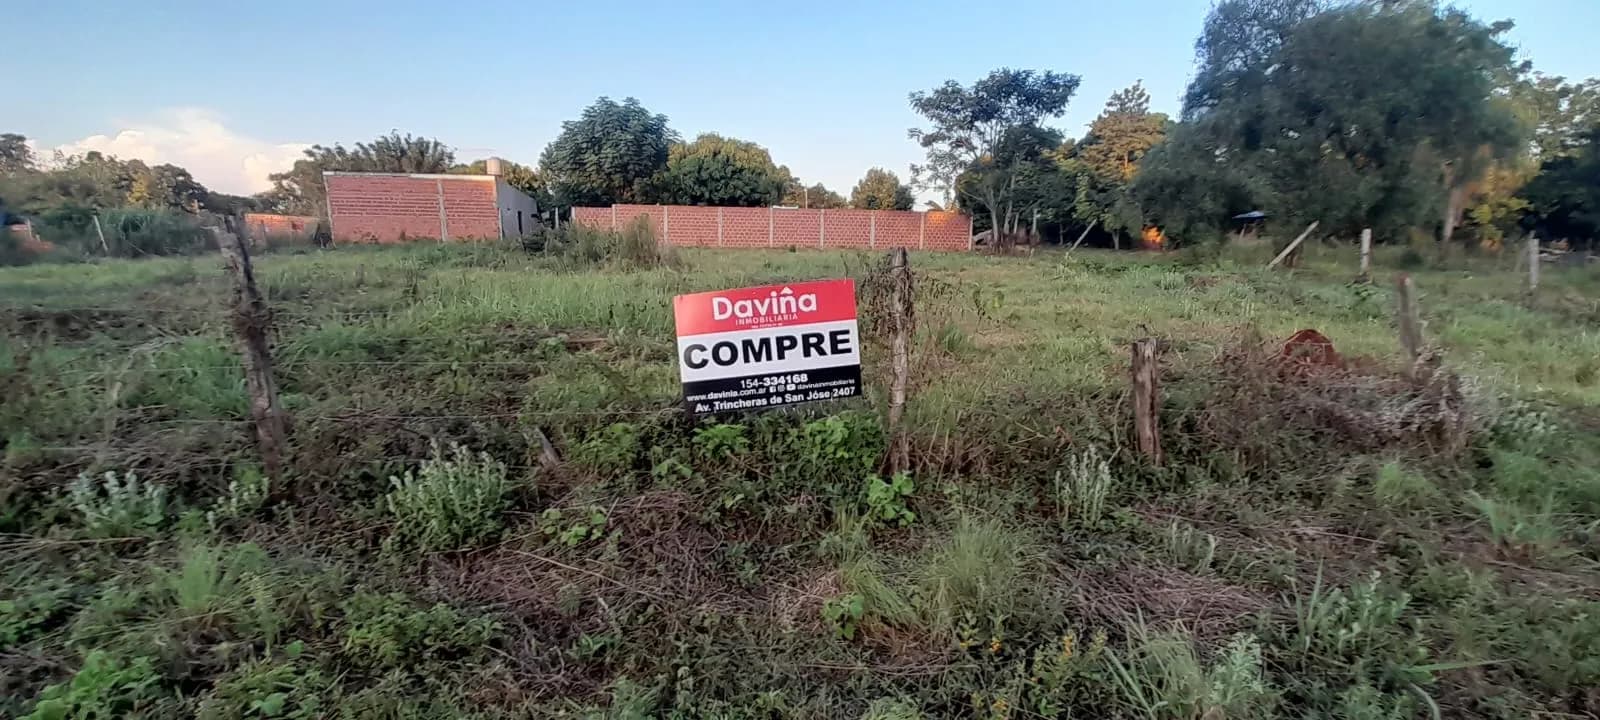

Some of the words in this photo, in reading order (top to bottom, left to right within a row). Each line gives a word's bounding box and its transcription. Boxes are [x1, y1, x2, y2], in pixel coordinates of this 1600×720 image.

[735, 313, 798, 326] INMOBILIARIA
[683, 329, 852, 370] COMPRE
[740, 373, 808, 389] 154-334168
[686, 387, 767, 402] www.davinia.com.ar
[694, 402, 712, 413] Av.
[713, 398, 768, 411] Trincheras
[769, 394, 783, 405] de
[784, 391, 804, 403] San
[832, 386, 855, 398] 2407
